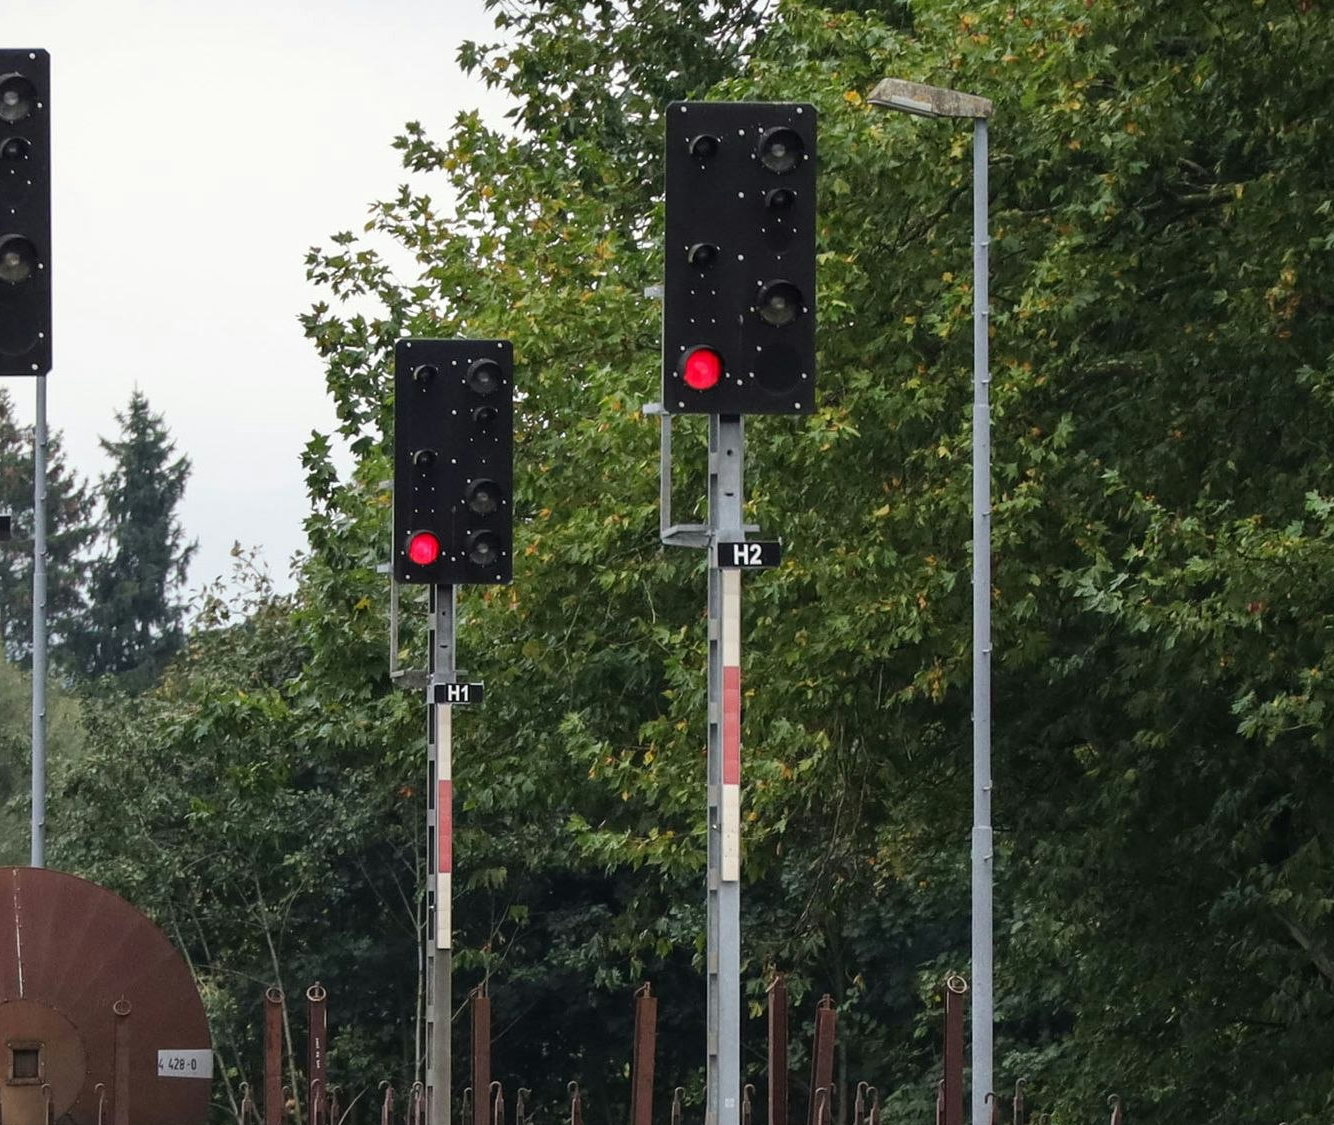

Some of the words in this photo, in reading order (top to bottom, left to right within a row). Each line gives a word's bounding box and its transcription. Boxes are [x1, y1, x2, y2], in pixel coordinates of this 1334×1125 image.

[733, 543, 763, 566] H2
[447, 684, 469, 702] H1
[168, 1058, 197, 1071] 428-0
